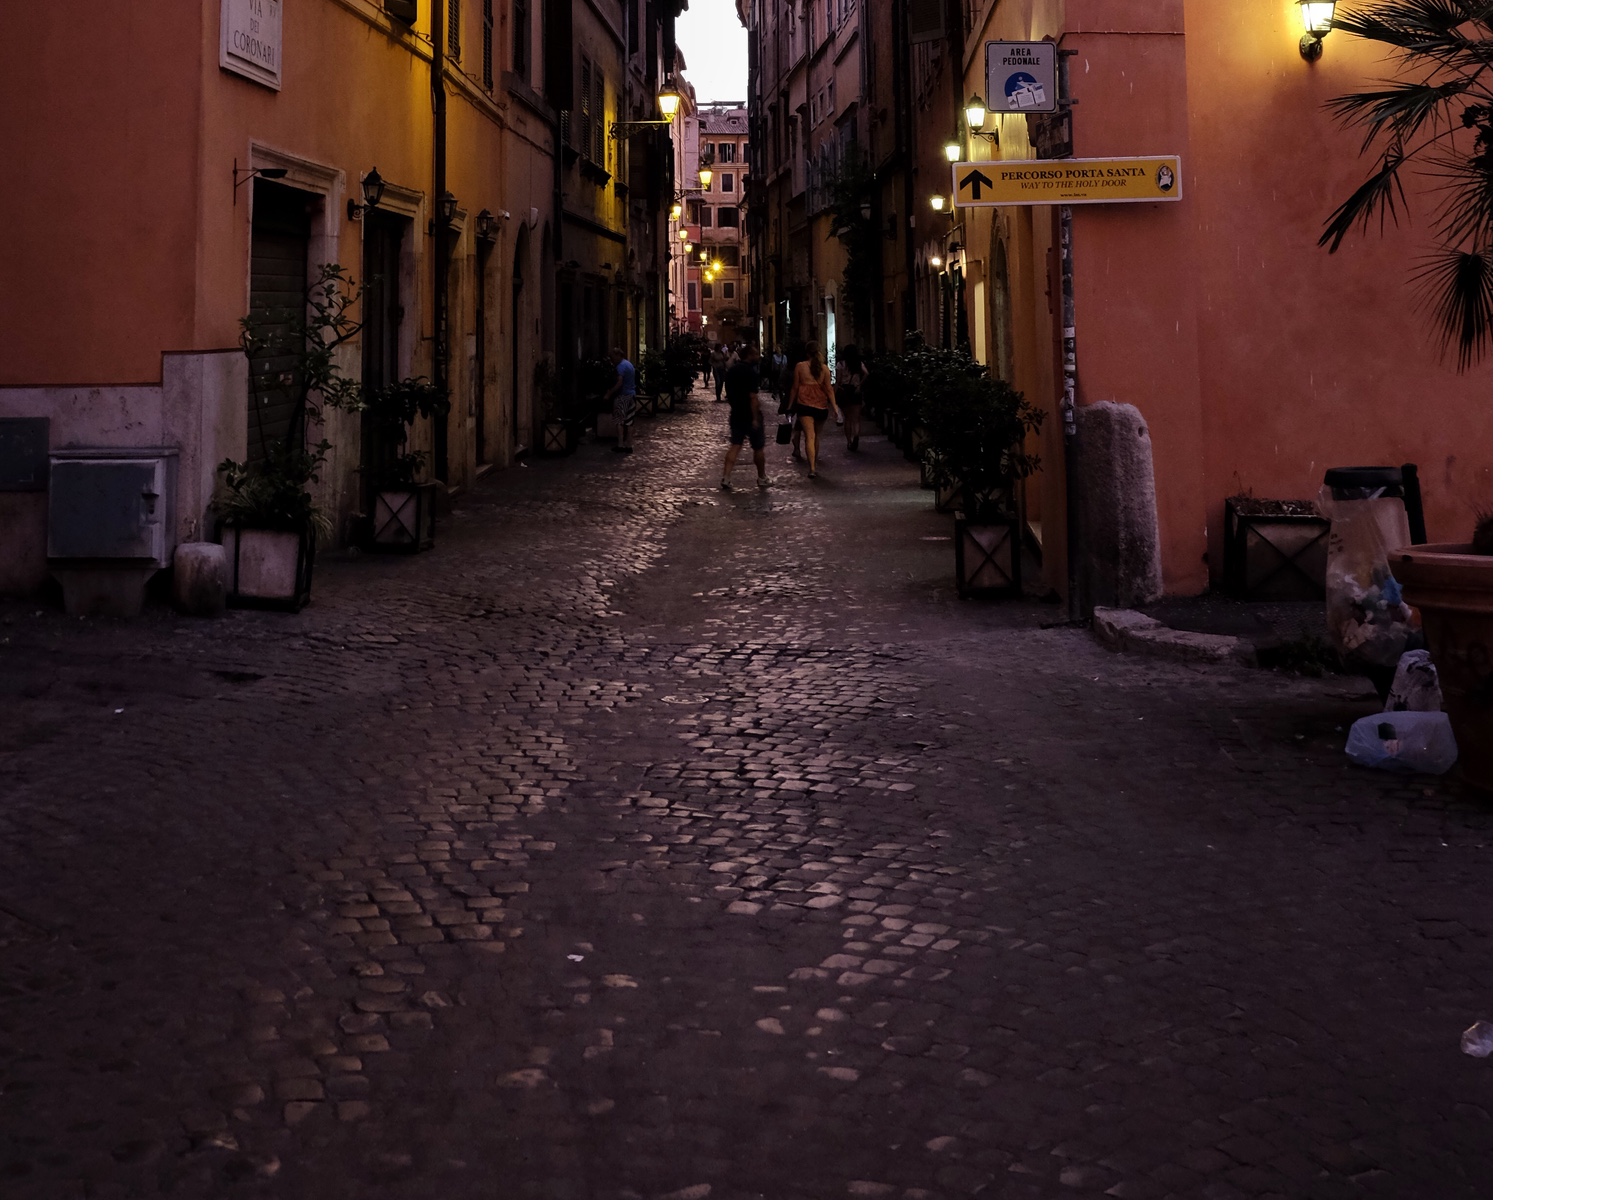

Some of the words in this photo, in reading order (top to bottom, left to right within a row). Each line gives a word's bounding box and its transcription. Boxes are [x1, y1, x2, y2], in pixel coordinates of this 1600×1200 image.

[250, 17, 260, 34] DEI
[233, 30, 275, 67] CORONARI
[1010, 48, 1031, 56] AREA
[1002, 57, 1040, 66] PEDONALE
[1001, 170, 1063, 180] PERCORSO
[1065, 169, 1104, 179] PORTA
[1106, 167, 1146, 177] SANTA
[1042, 181, 1054, 189] TO
[1056, 180, 1074, 189] THE
[1075, 180, 1101, 188] HOLY
[1101, 179, 1127, 187] DOOR
